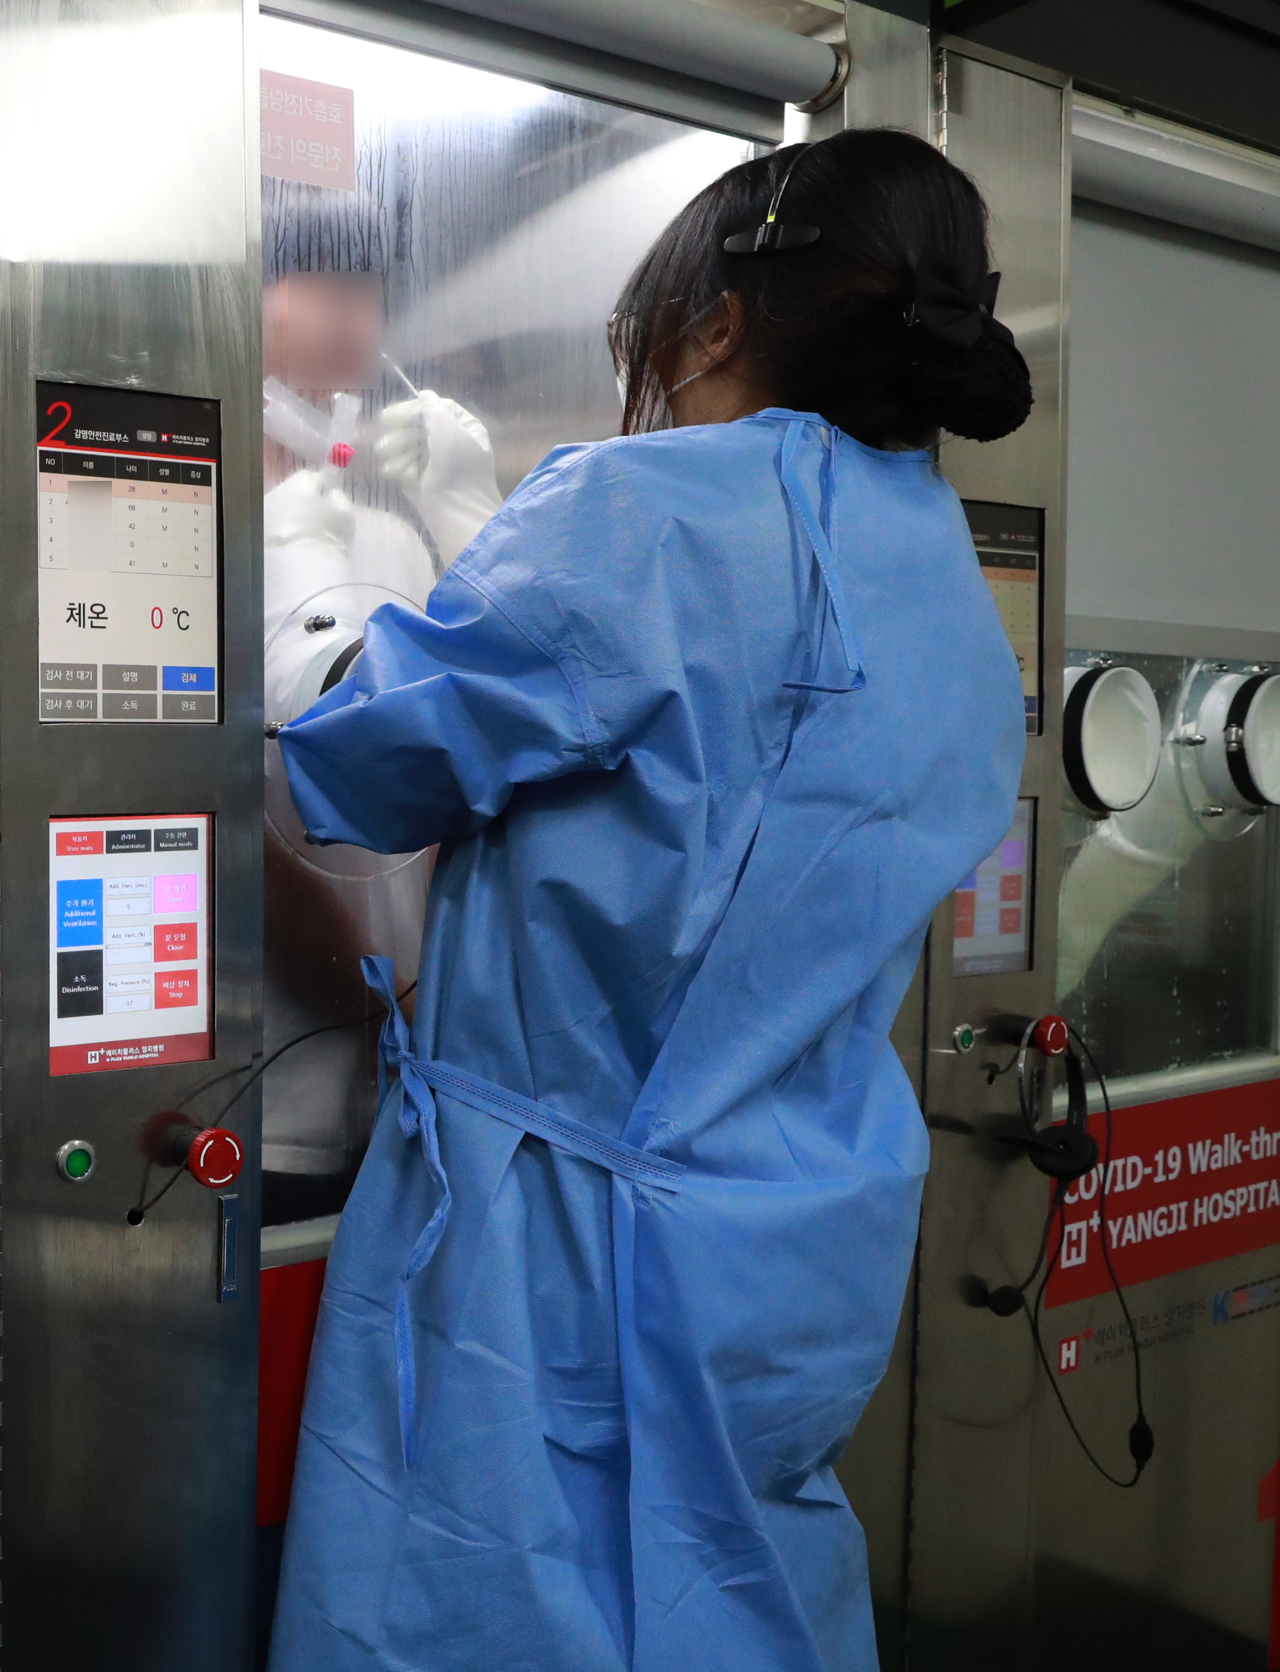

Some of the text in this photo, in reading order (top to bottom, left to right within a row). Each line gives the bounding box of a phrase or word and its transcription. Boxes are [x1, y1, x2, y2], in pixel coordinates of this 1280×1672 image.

[38, 401, 72, 446] 2
[74, 429, 130, 443] 감염안전진료부스
[45, 458, 56, 466] NO
[82, 461, 94, 470] 이름
[126, 465, 138, 473] 나이
[158, 468, 170, 476] 성별
[66, 602, 108, 629] 체온
[151, 606, 163, 629] 0
[46, 670, 93, 681] 검사 전 대기
[122, 671, 138, 682] 설명
[181, 673, 197, 683] 검체
[46, 699, 93, 710] 검사 후 대기
[122, 700, 138, 710] 소독
[181, 701, 197, 712] 완료
[66, 900, 78, 908] 추가
[63, 919, 97, 927] Ventilation
[62, 985, 98, 994] Disinfection
[106, 1044, 164, 1056] 에이치플러스 양지병원
[1108, 1201, 1188, 1249] YANGJI
